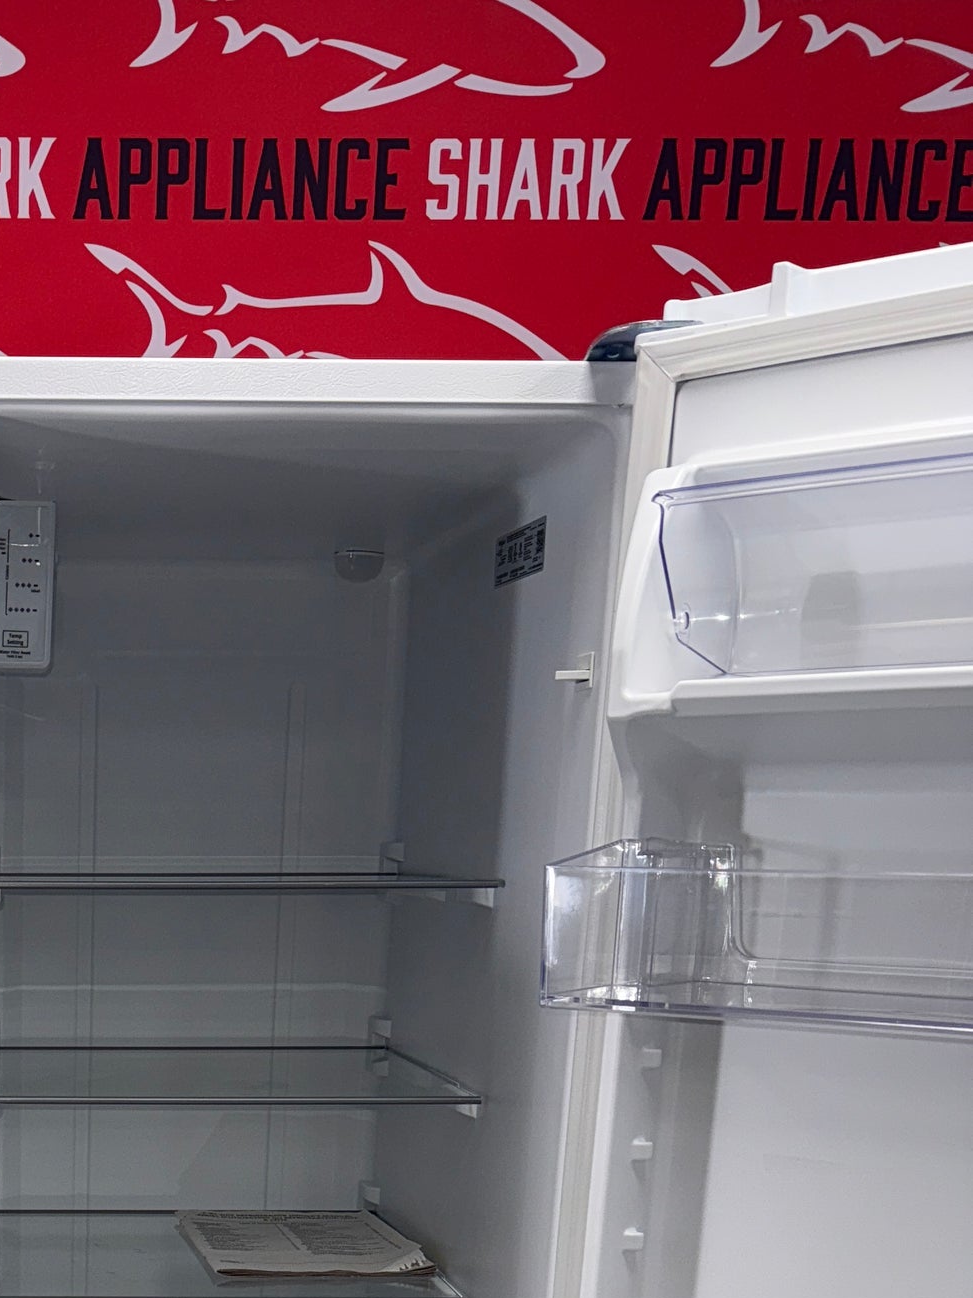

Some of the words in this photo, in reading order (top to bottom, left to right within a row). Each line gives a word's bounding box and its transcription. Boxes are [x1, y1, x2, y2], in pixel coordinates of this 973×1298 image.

[73, 137, 409, 220] APPLIANCE
[425, 138, 630, 221] SHARK
[643, 138, 973, 221] APPLIANCE
